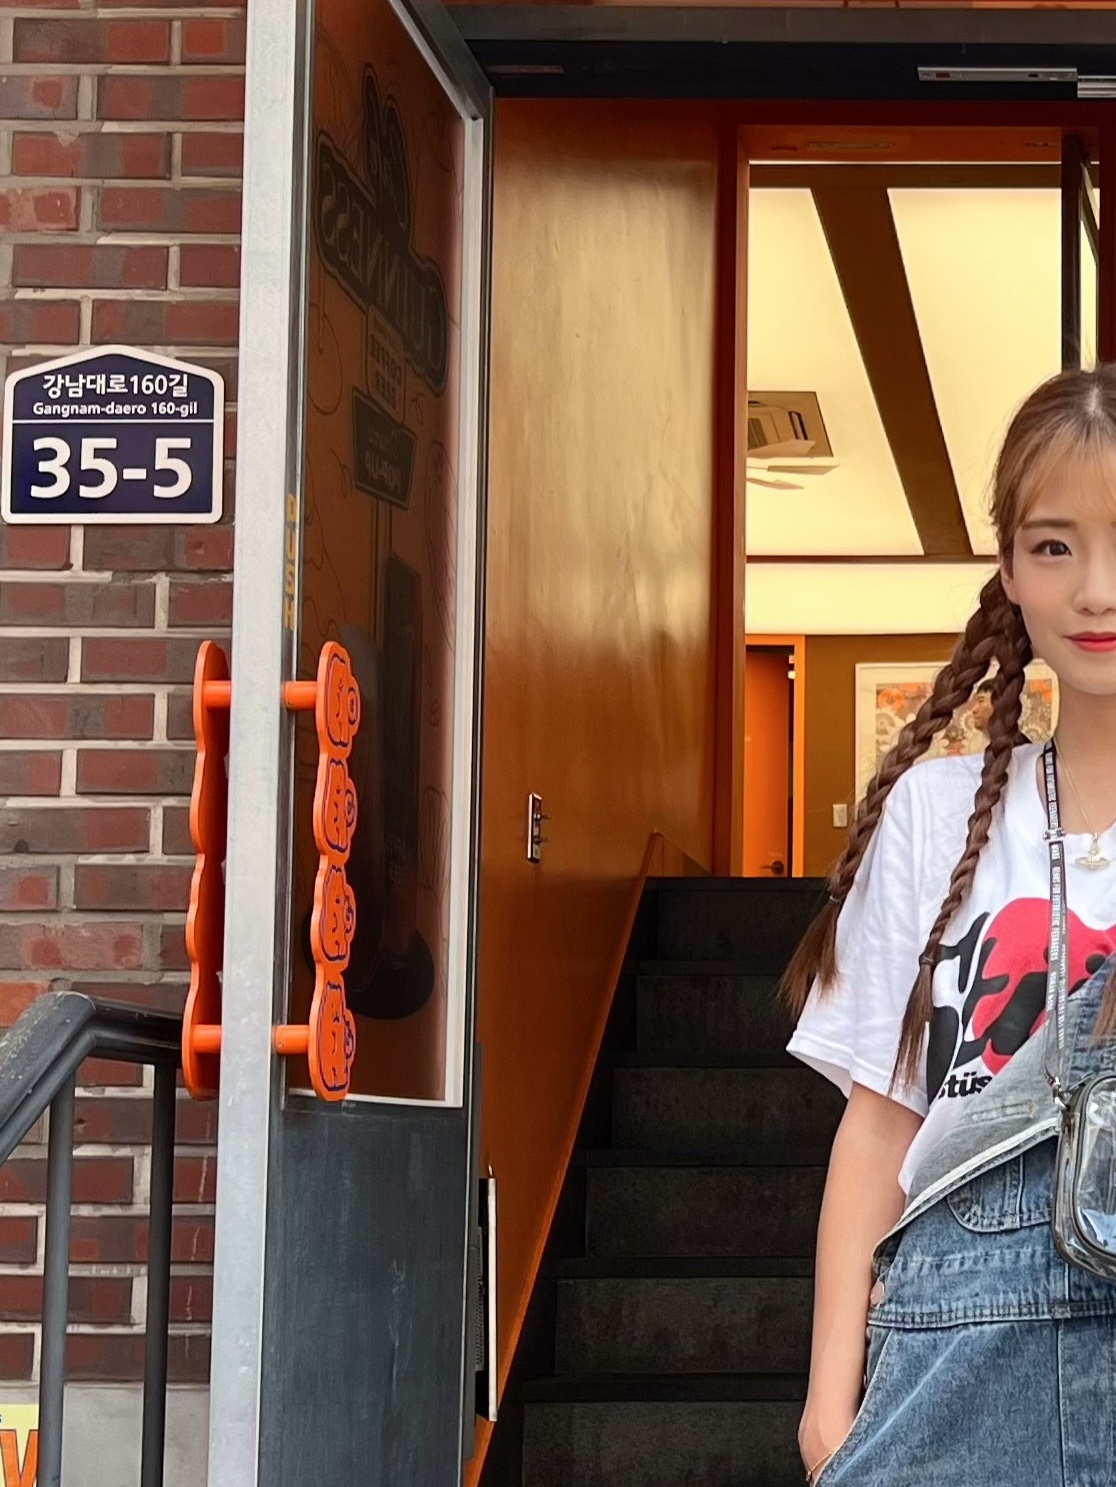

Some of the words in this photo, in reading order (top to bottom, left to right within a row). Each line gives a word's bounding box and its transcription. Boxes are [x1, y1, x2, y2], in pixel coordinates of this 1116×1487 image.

[42, 374, 188, 399] 강남대로160길
[33, 402, 147, 418] Gangnam-daero
[151, 402, 198, 417] 160-gil
[30, 436, 193, 499] 35-5
[938, 1070, 993, 1100] tüs
